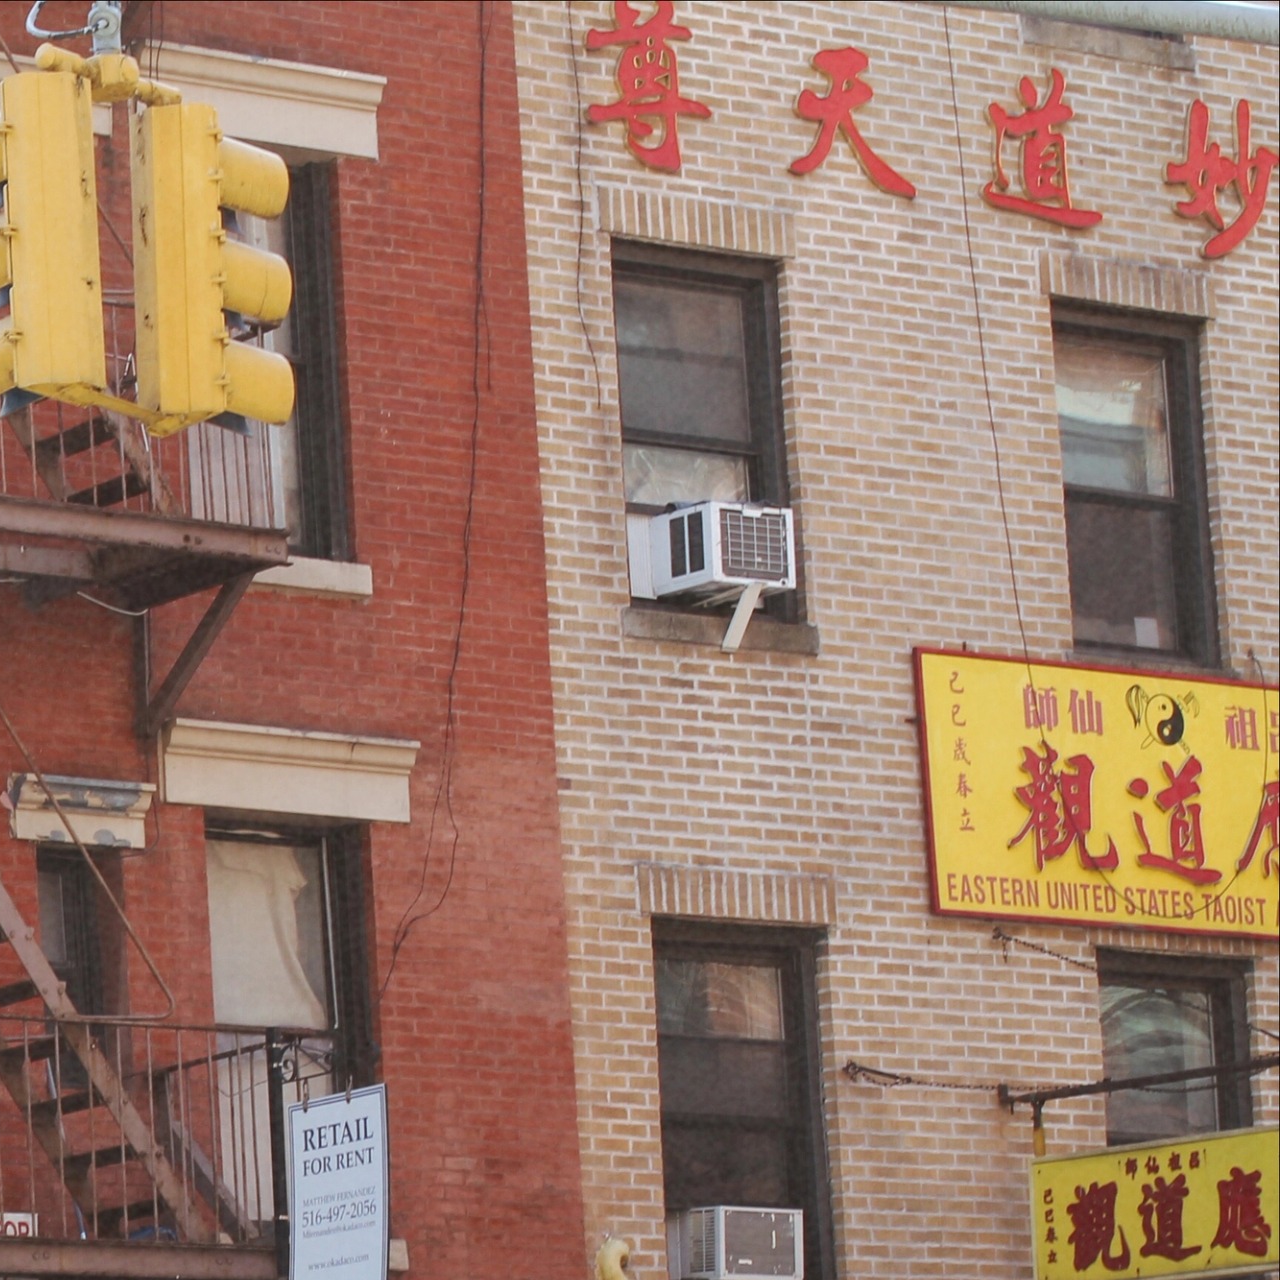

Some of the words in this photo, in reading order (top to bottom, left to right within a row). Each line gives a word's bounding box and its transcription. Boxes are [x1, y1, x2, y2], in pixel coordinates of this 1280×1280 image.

[946, 873, 1040, 908] EASTERN
[1046, 881, 1117, 914] UNITED
[1124, 887, 1195, 920] STATES
[1201, 893, 1267, 926] TAOIST
[302, 1116, 374, 1152] RETAIL
[302, 1156, 332, 1177] FOR
[336, 1147, 375, 1171] RENT
[302, 1198, 377, 1228] 516-497-2056
